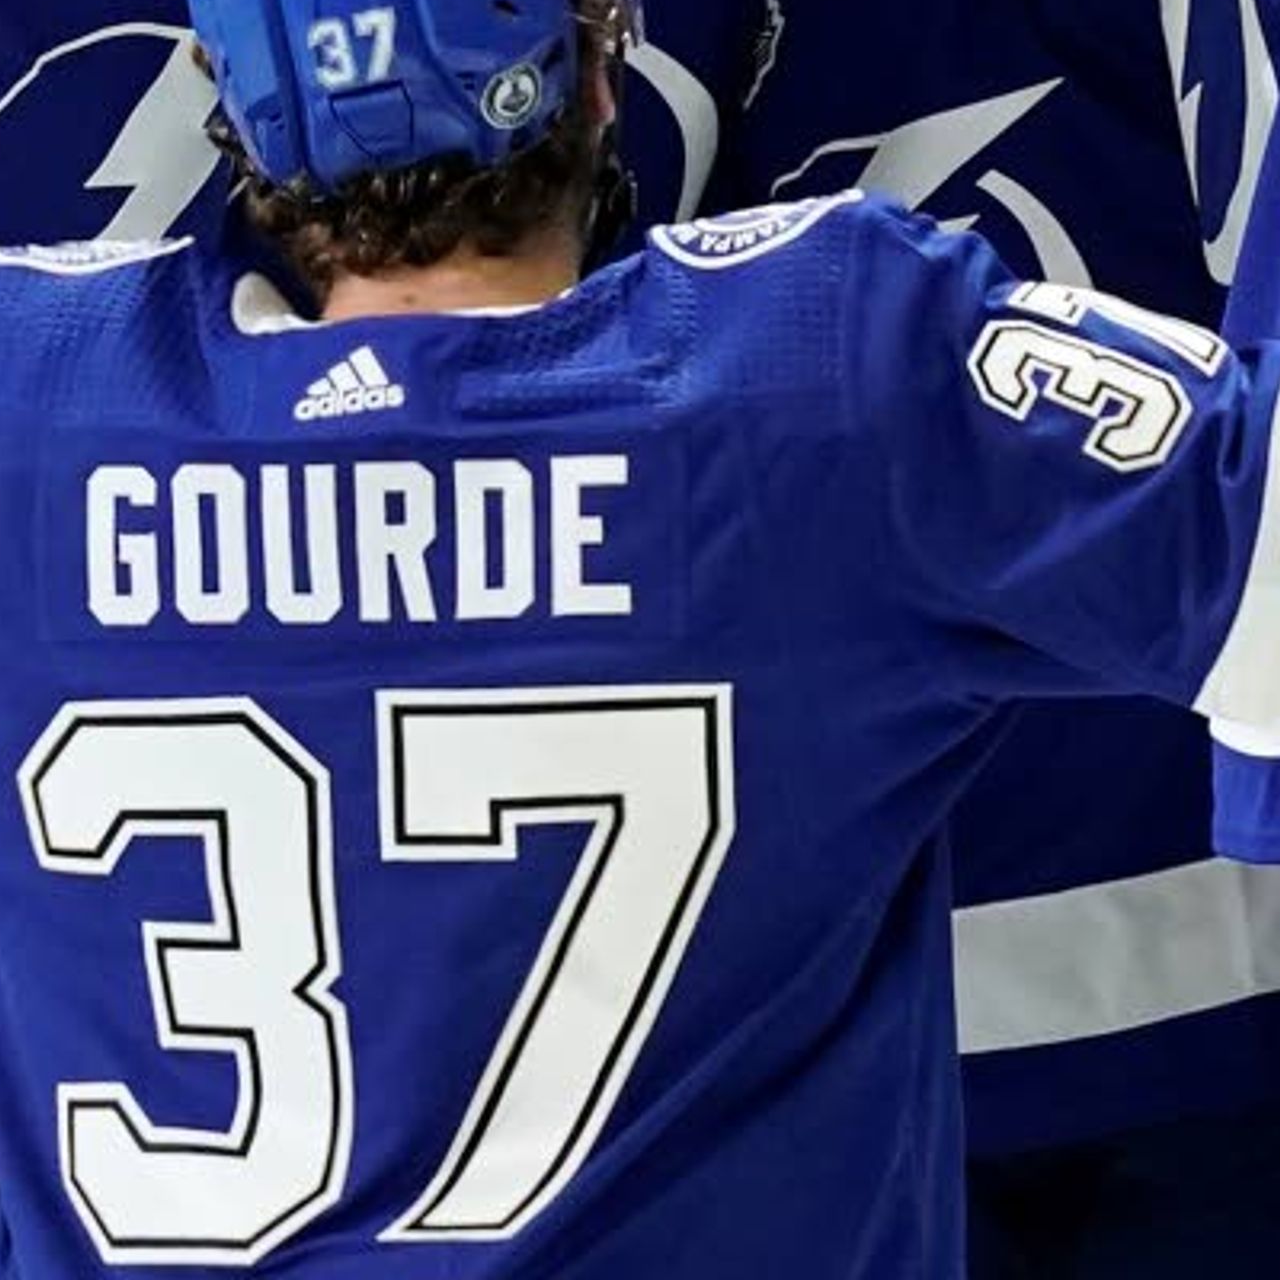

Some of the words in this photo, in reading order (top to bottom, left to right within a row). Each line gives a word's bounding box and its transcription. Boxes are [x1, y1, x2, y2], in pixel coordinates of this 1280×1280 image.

[308, 7, 396, 90] 37
[293, 384, 405, 420] adidas
[86, 454, 633, 626] GOURDE
[16, 682, 735, 1266] 37
